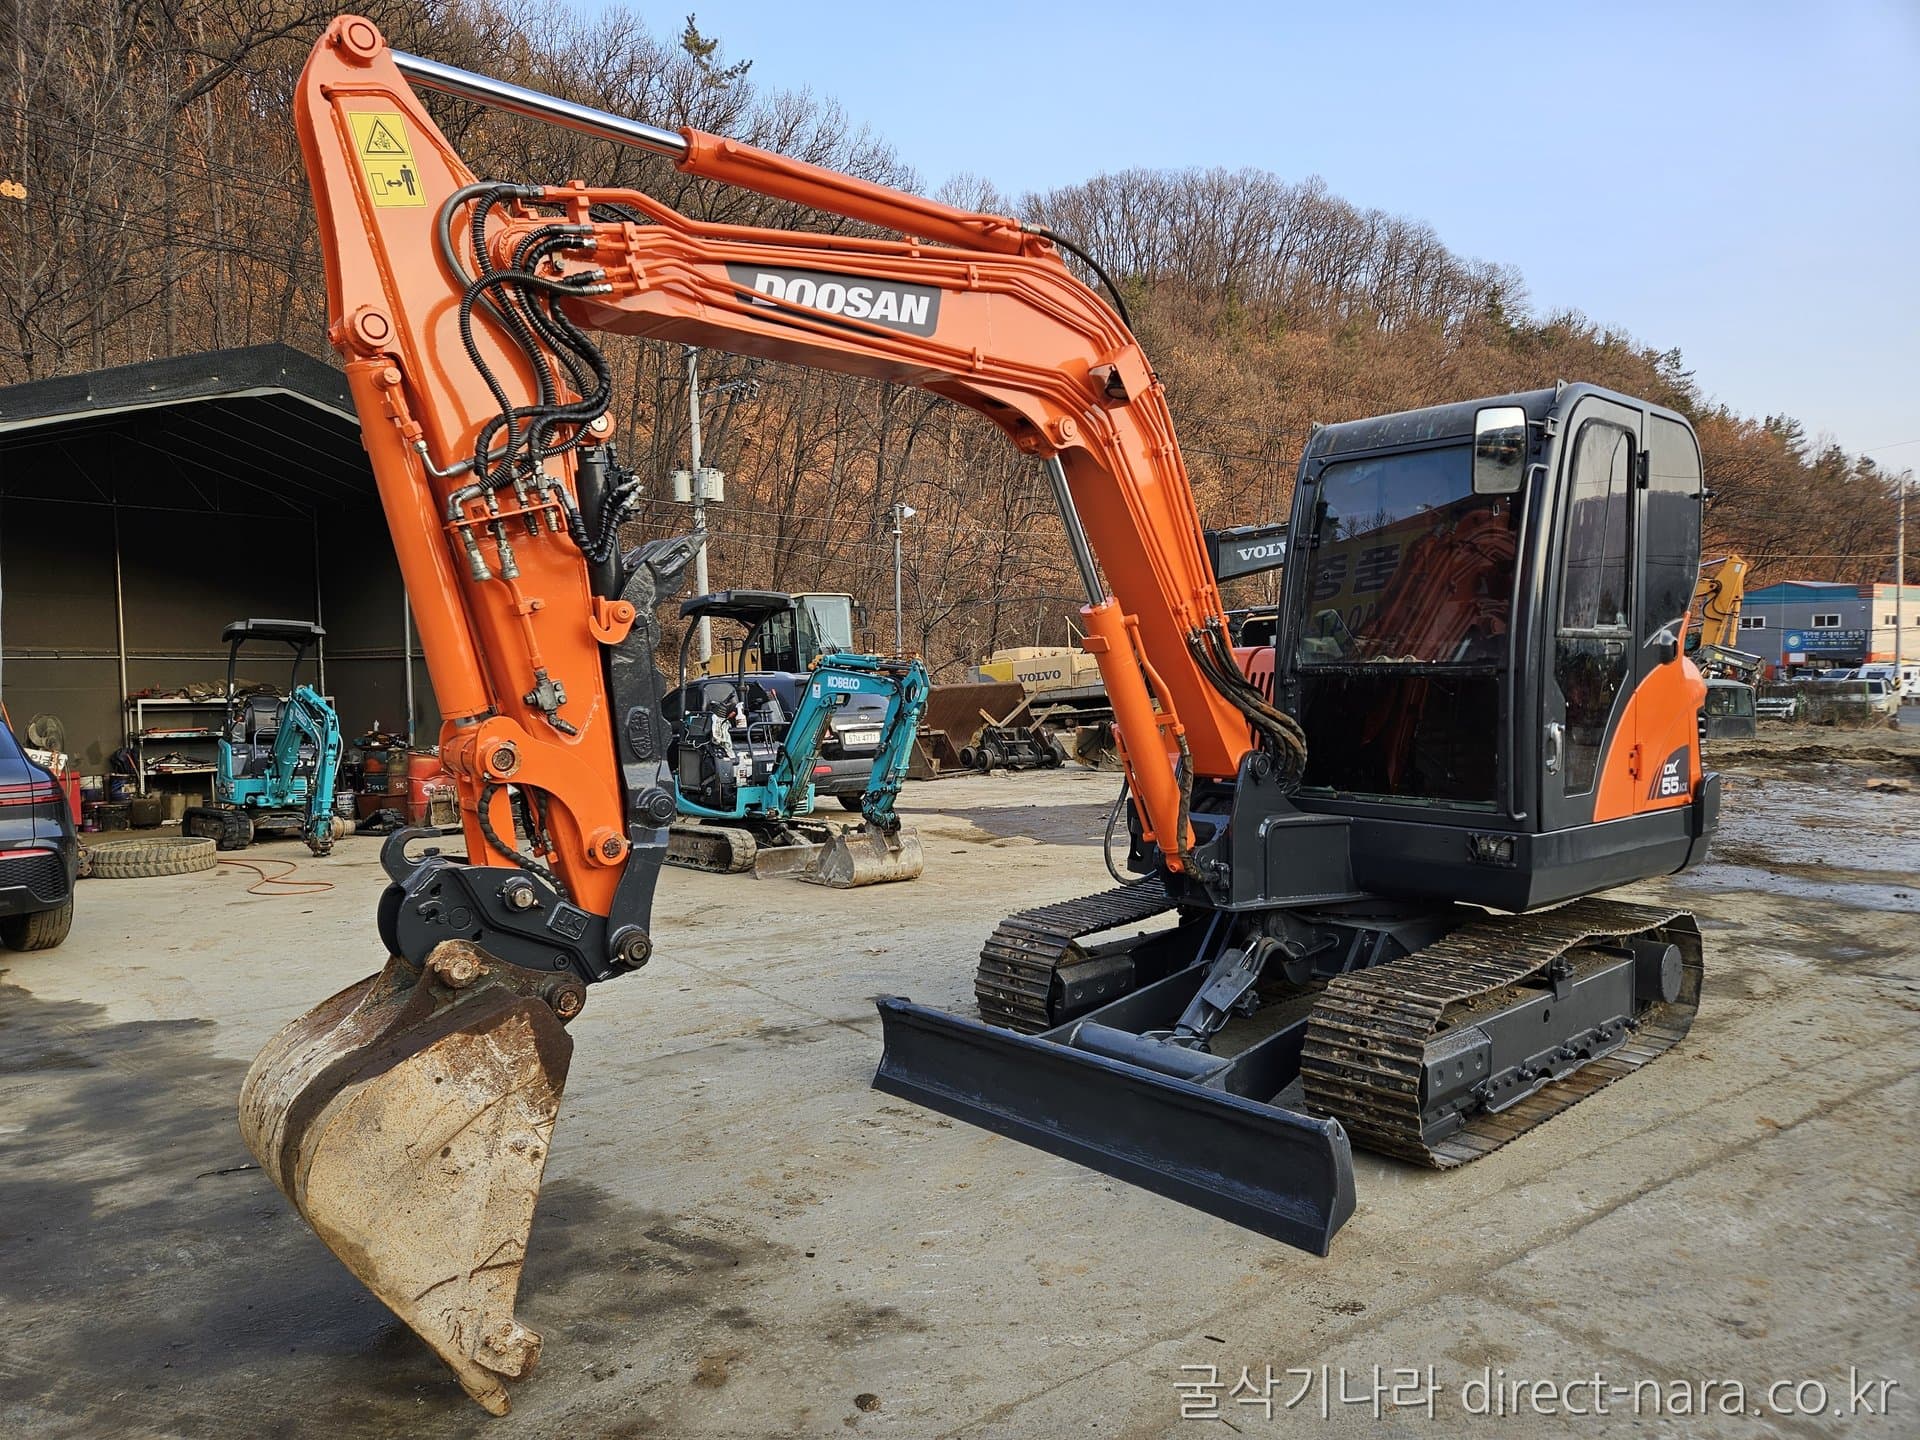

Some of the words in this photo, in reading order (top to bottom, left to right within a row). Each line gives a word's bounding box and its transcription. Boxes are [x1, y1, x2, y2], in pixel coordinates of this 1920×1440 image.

[752, 273, 930, 325] DOOSAN
[1237, 541, 1287, 561] VOLV
[827, 676, 860, 690] KOBELCO
[1017, 670, 1061, 682] VOLVO
[1664, 759, 1680, 775] DX
[1661, 776, 1679, 795] 55
